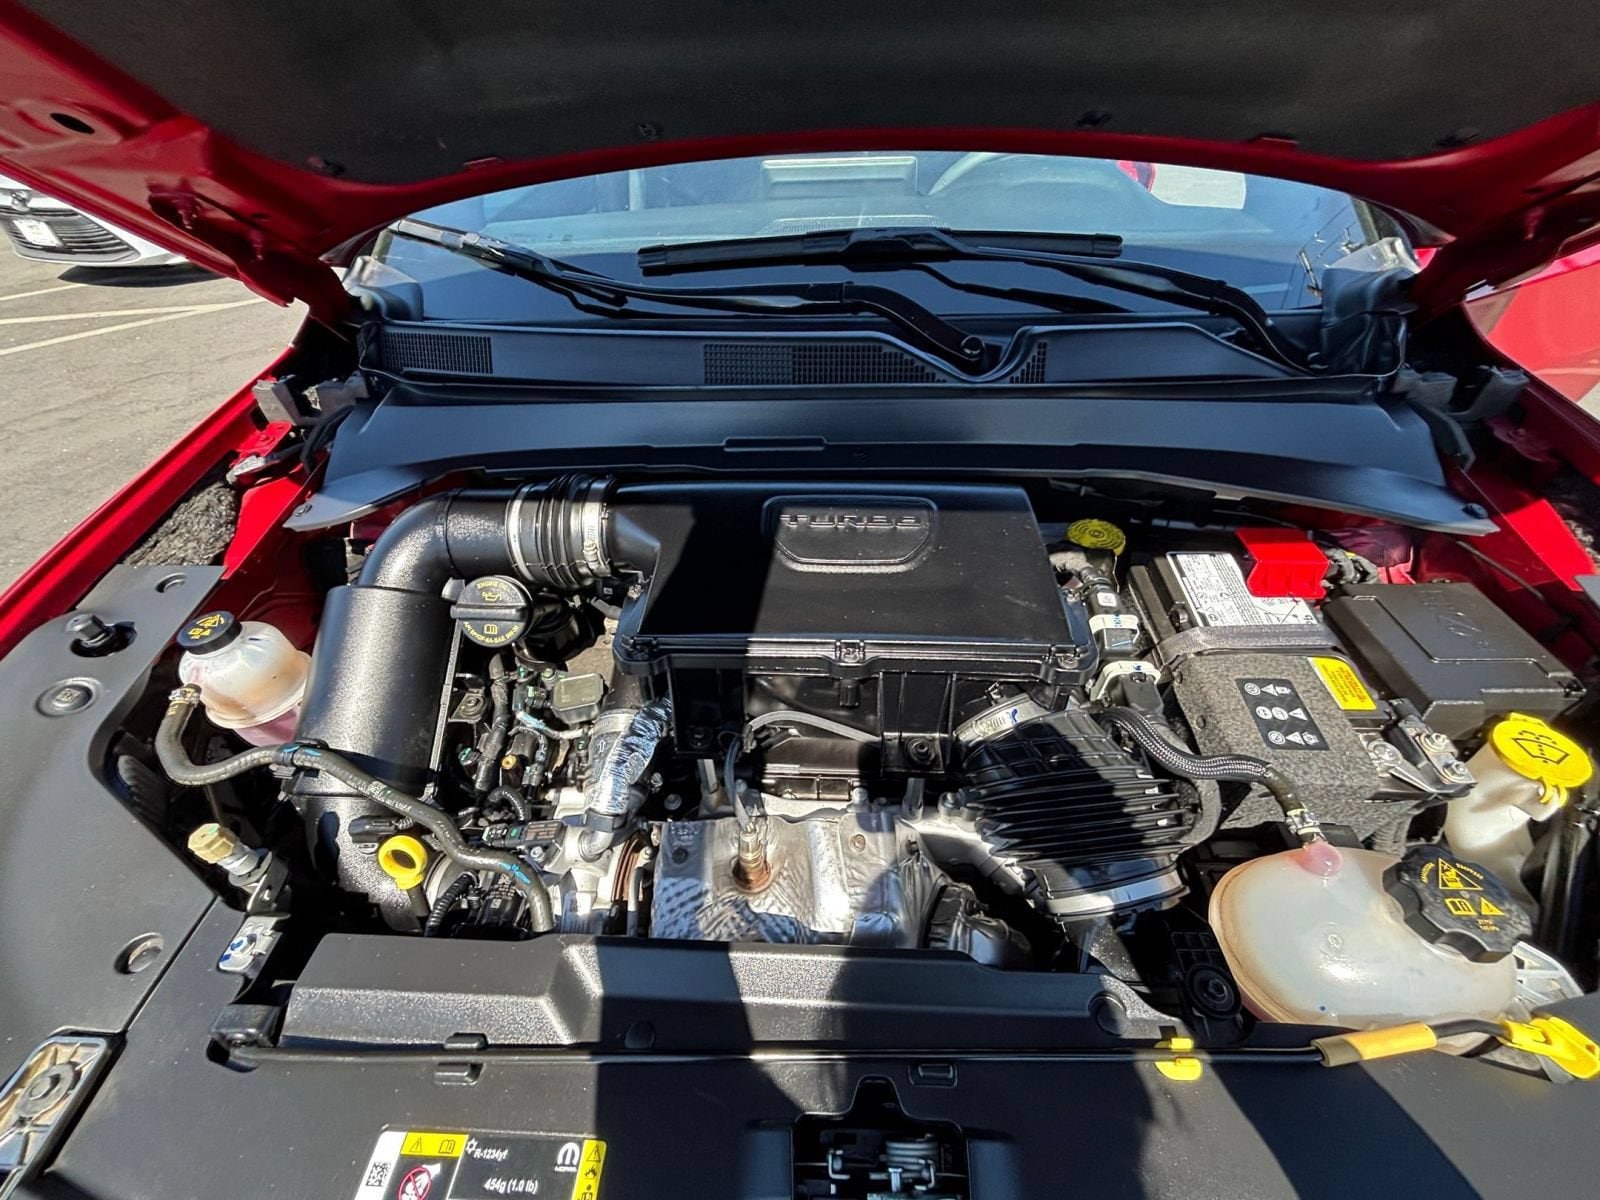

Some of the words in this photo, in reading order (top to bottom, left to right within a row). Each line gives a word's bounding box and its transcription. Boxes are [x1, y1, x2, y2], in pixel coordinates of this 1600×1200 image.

[779, 513, 921, 529] TURBO
[476, 580, 498, 590] ENGINE
[473, 1148, 509, 1162] R-1234yf
[483, 1177, 506, 1195] 454g
[507, 1179, 524, 1194] (1.0
[525, 1179, 539, 1195] lb)
